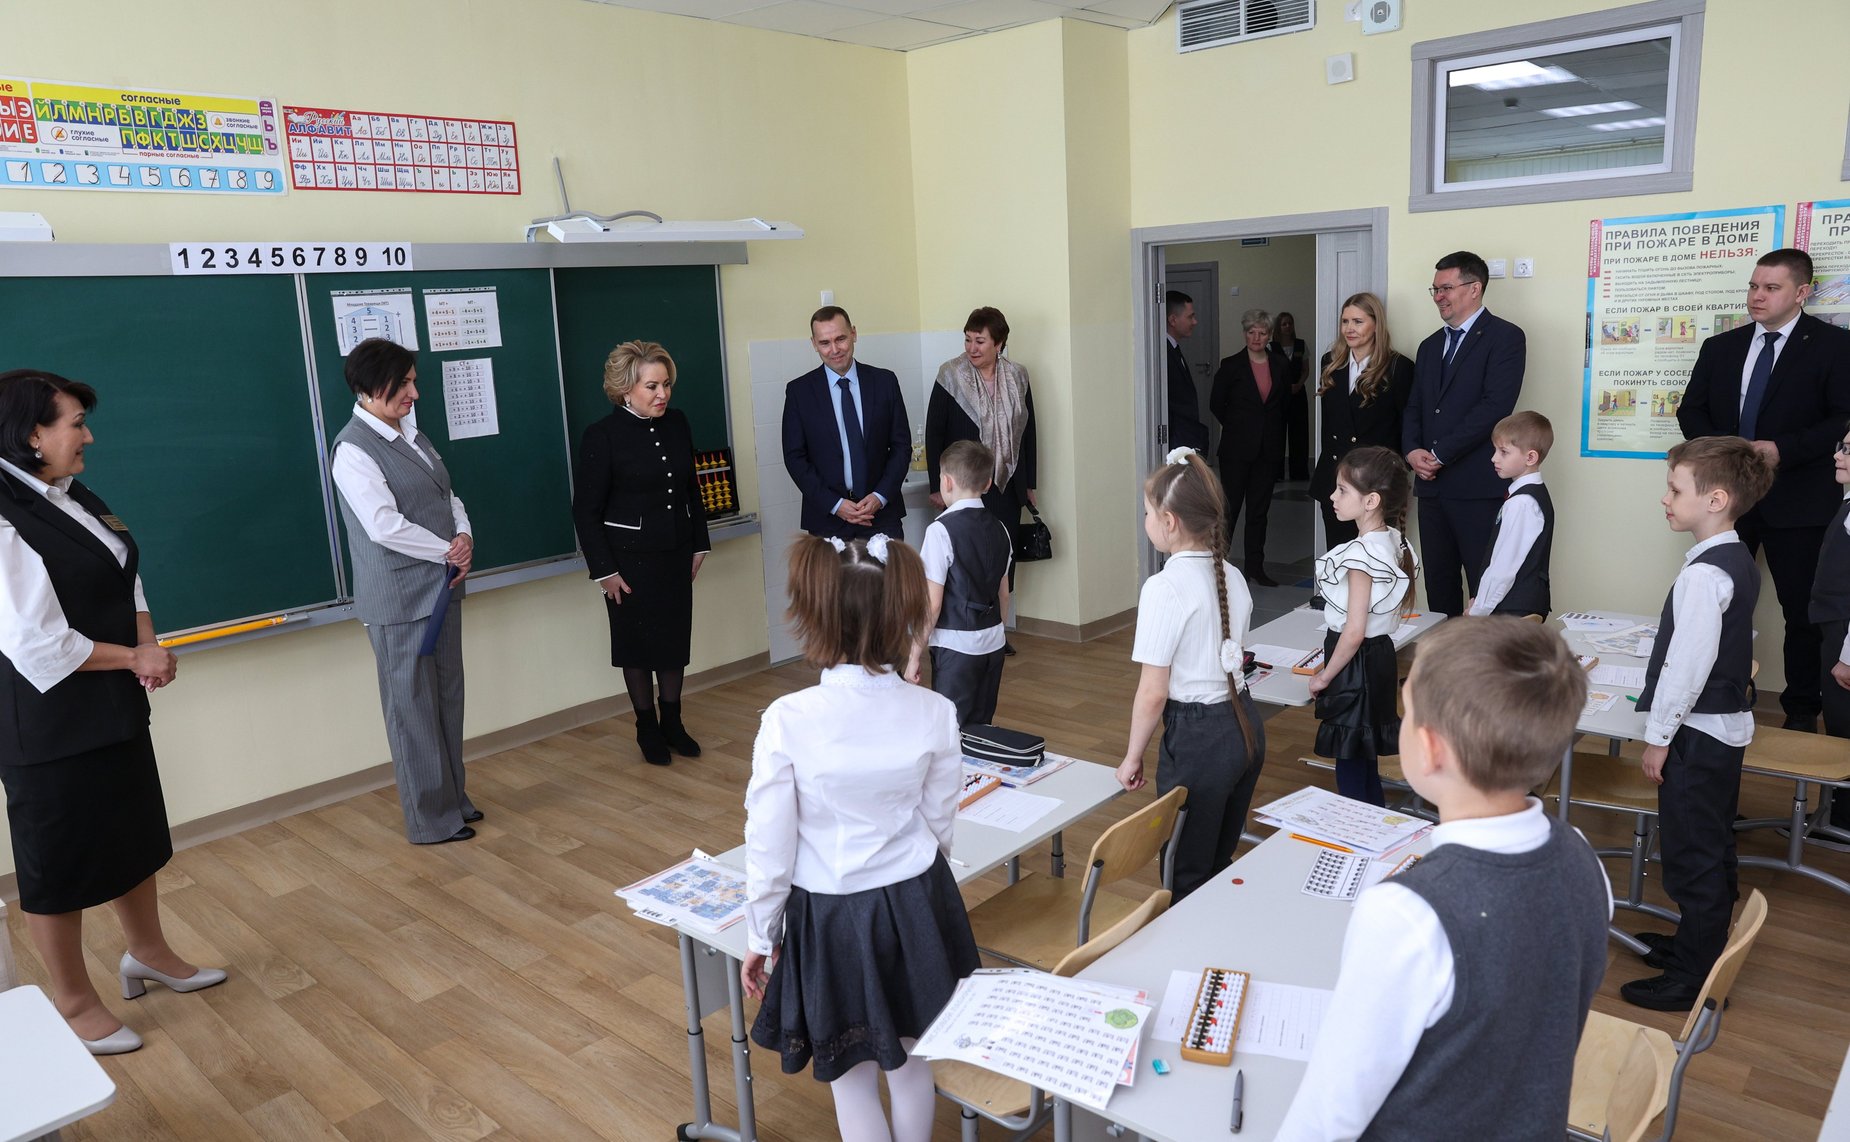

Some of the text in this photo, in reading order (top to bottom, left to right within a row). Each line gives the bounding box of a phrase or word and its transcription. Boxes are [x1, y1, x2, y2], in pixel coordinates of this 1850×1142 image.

[120, 93, 181, 106] согласные
[289, 123, 352, 135] АЛФАВИТ
[71, 135, 109, 143] согласные
[21, 162, 273, 189] 1 2 3 4 5 6 7 8 9
[1605, 220, 1760, 240] ПРАВИЛА ПОВЕДЕНИЯ
[1605, 232, 1759, 251] ПРИ ПОЖАРЕ В ДОМЕ
[177, 247, 406, 269] 1 2 3 4 5 6 7 8 9 10
[1623, 255, 1659, 264] ПОЖАРЕ
[1700, 247, 1758, 259] НЕЛЬЗЯ:
[1672, 303, 1703, 311] СВОЕЙ
